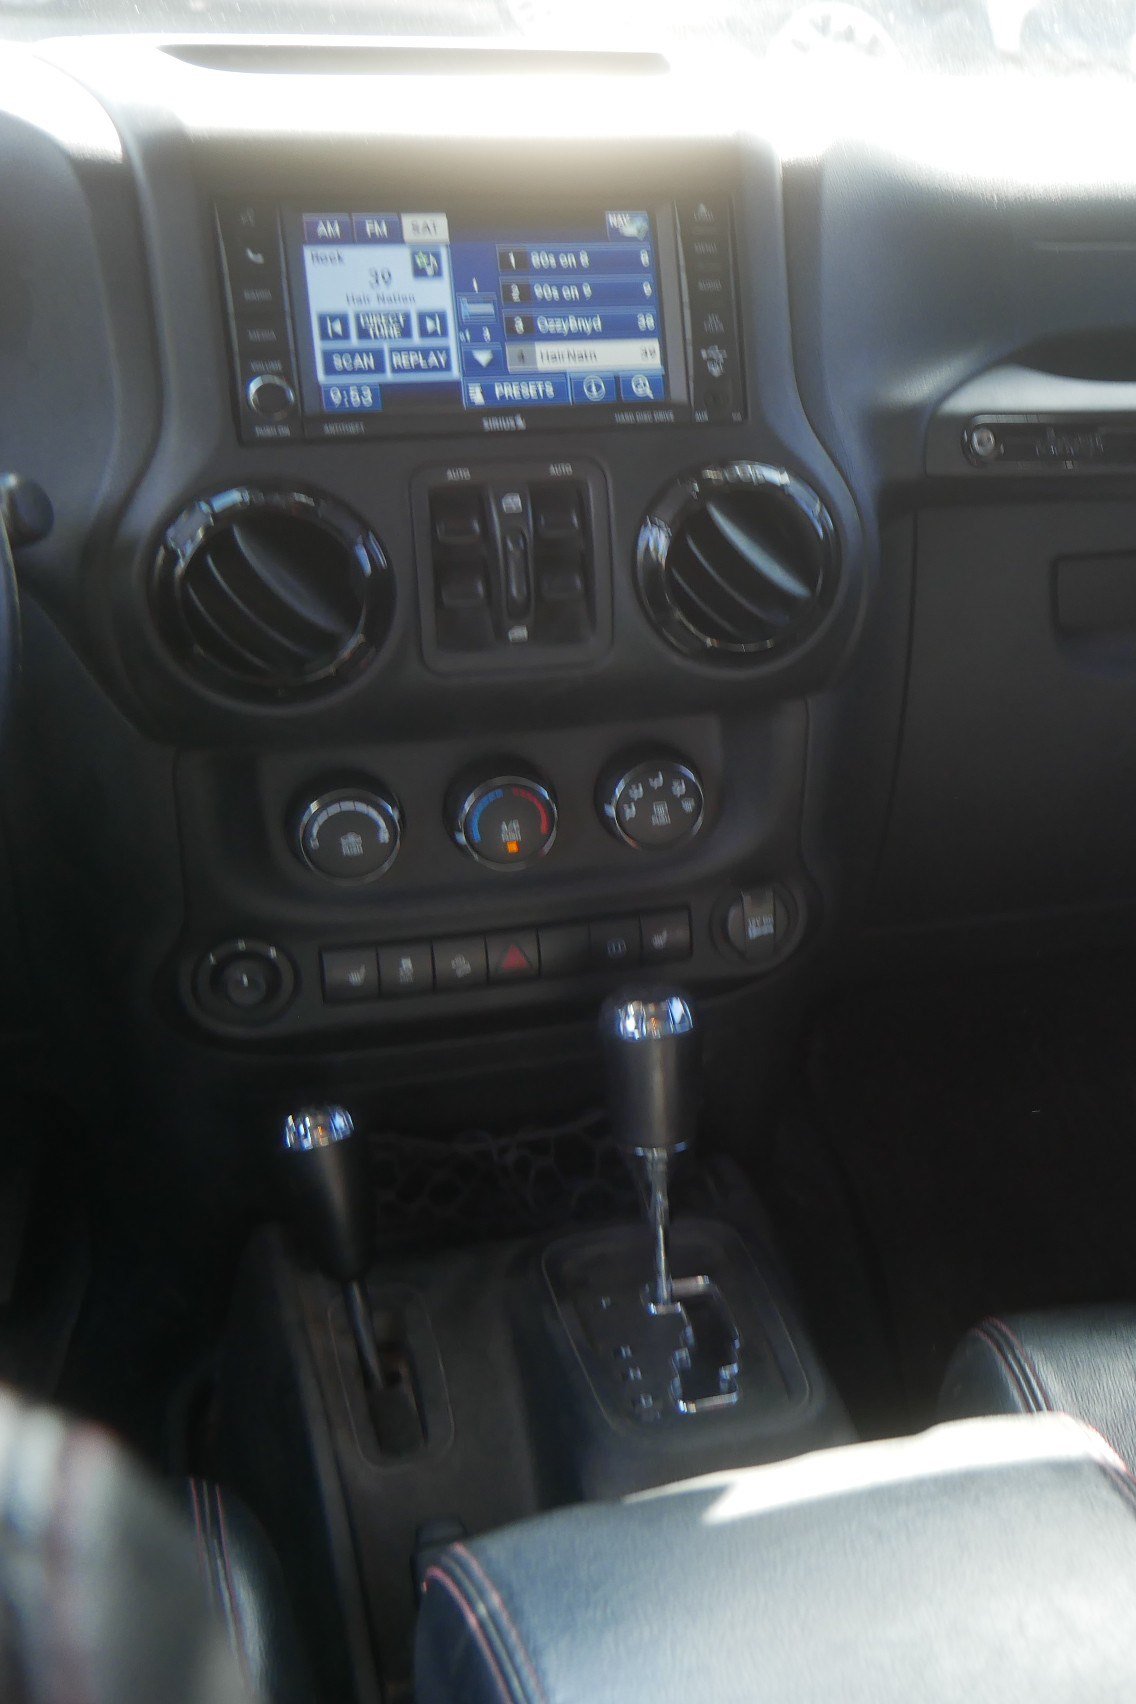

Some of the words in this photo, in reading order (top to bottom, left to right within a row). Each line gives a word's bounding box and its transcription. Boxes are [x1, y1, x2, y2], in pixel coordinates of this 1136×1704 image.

[317, 219, 341, 239] AM
[365, 219, 389, 239] FM
[608, 212, 631, 229] NAV
[332, 352, 375, 372] SCAN
[392, 350, 448, 369] REPLAY
[494, 380, 555, 401] PRESETS
